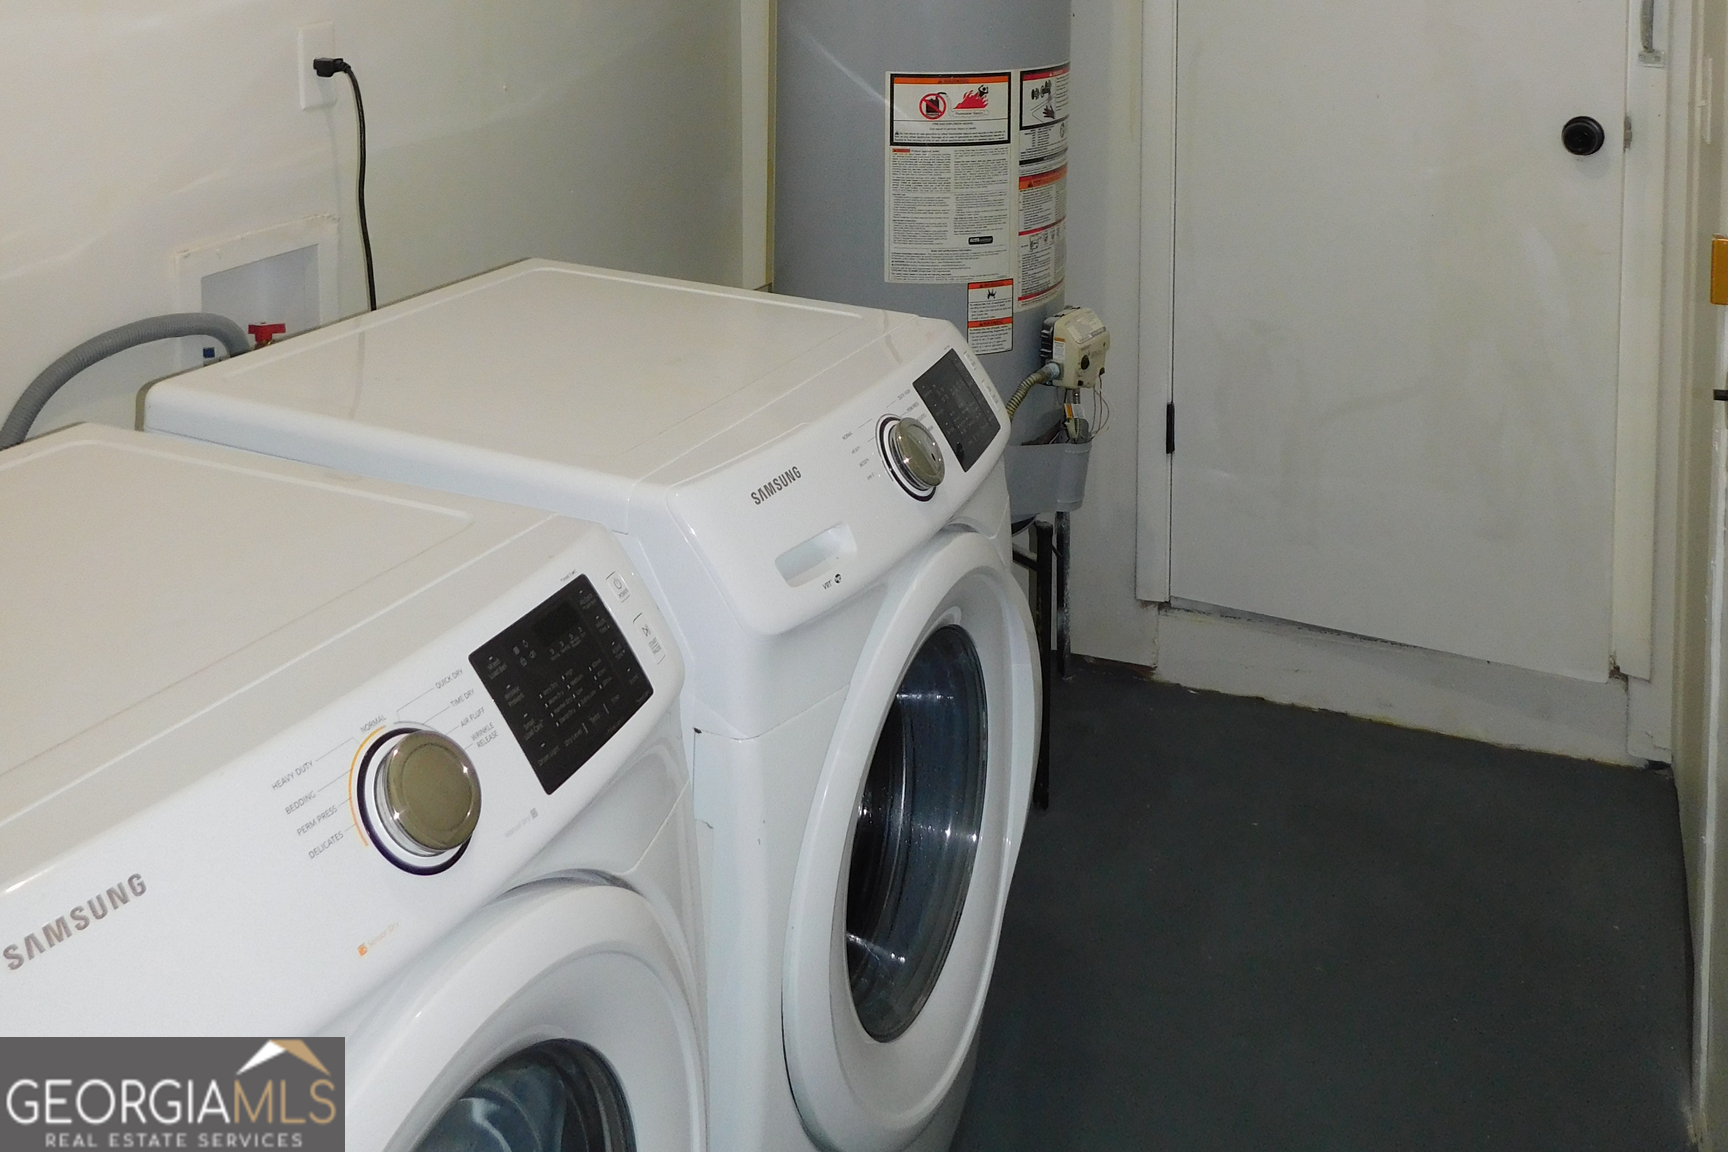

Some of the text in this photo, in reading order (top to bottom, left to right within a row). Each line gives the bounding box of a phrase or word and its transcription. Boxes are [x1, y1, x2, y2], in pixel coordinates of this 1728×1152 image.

[751, 466, 802, 505] SAMSUNG
[435, 668, 463, 689] QUICK DRY
[450, 688, 474, 707] TIME DRY
[360, 715, 386, 733] NORMAL
[460, 707, 485, 727] AIR FLUFF
[470, 721, 494, 741] WRINKLE
[476, 730, 498, 748] RELEASE
[271, 760, 314, 791] HEAVY DUTY
[285, 790, 317, 815] BEDDING
[297, 805, 338, 836] PERM PRESS
[308, 831, 344, 859] DELICATES
[3, 873, 147, 970] SAMSUNG
